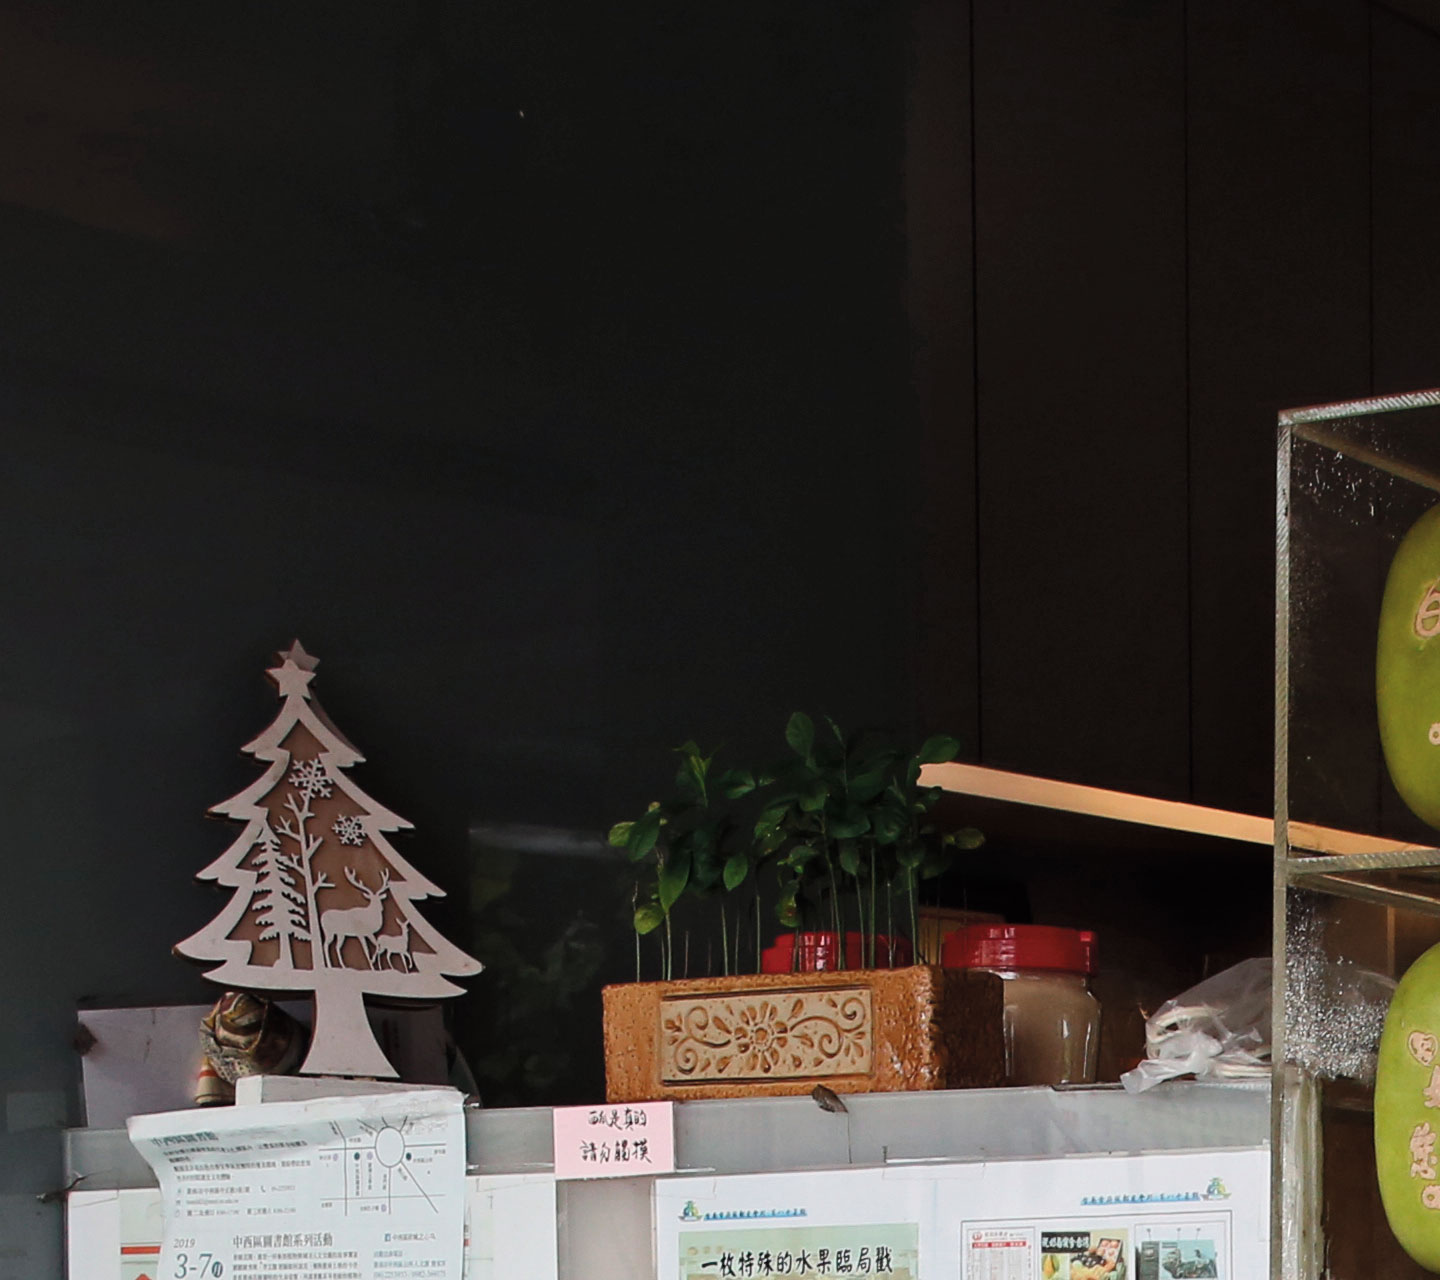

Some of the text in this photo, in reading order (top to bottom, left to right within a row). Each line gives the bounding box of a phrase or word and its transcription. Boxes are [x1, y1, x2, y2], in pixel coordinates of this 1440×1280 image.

[173, 1237, 195, 1249] 2019
[232, 1232, 333, 1248] 中西區圖書館系列活動
[701, 1246, 893, 1278] 一枚特殊的水果臨局戳
